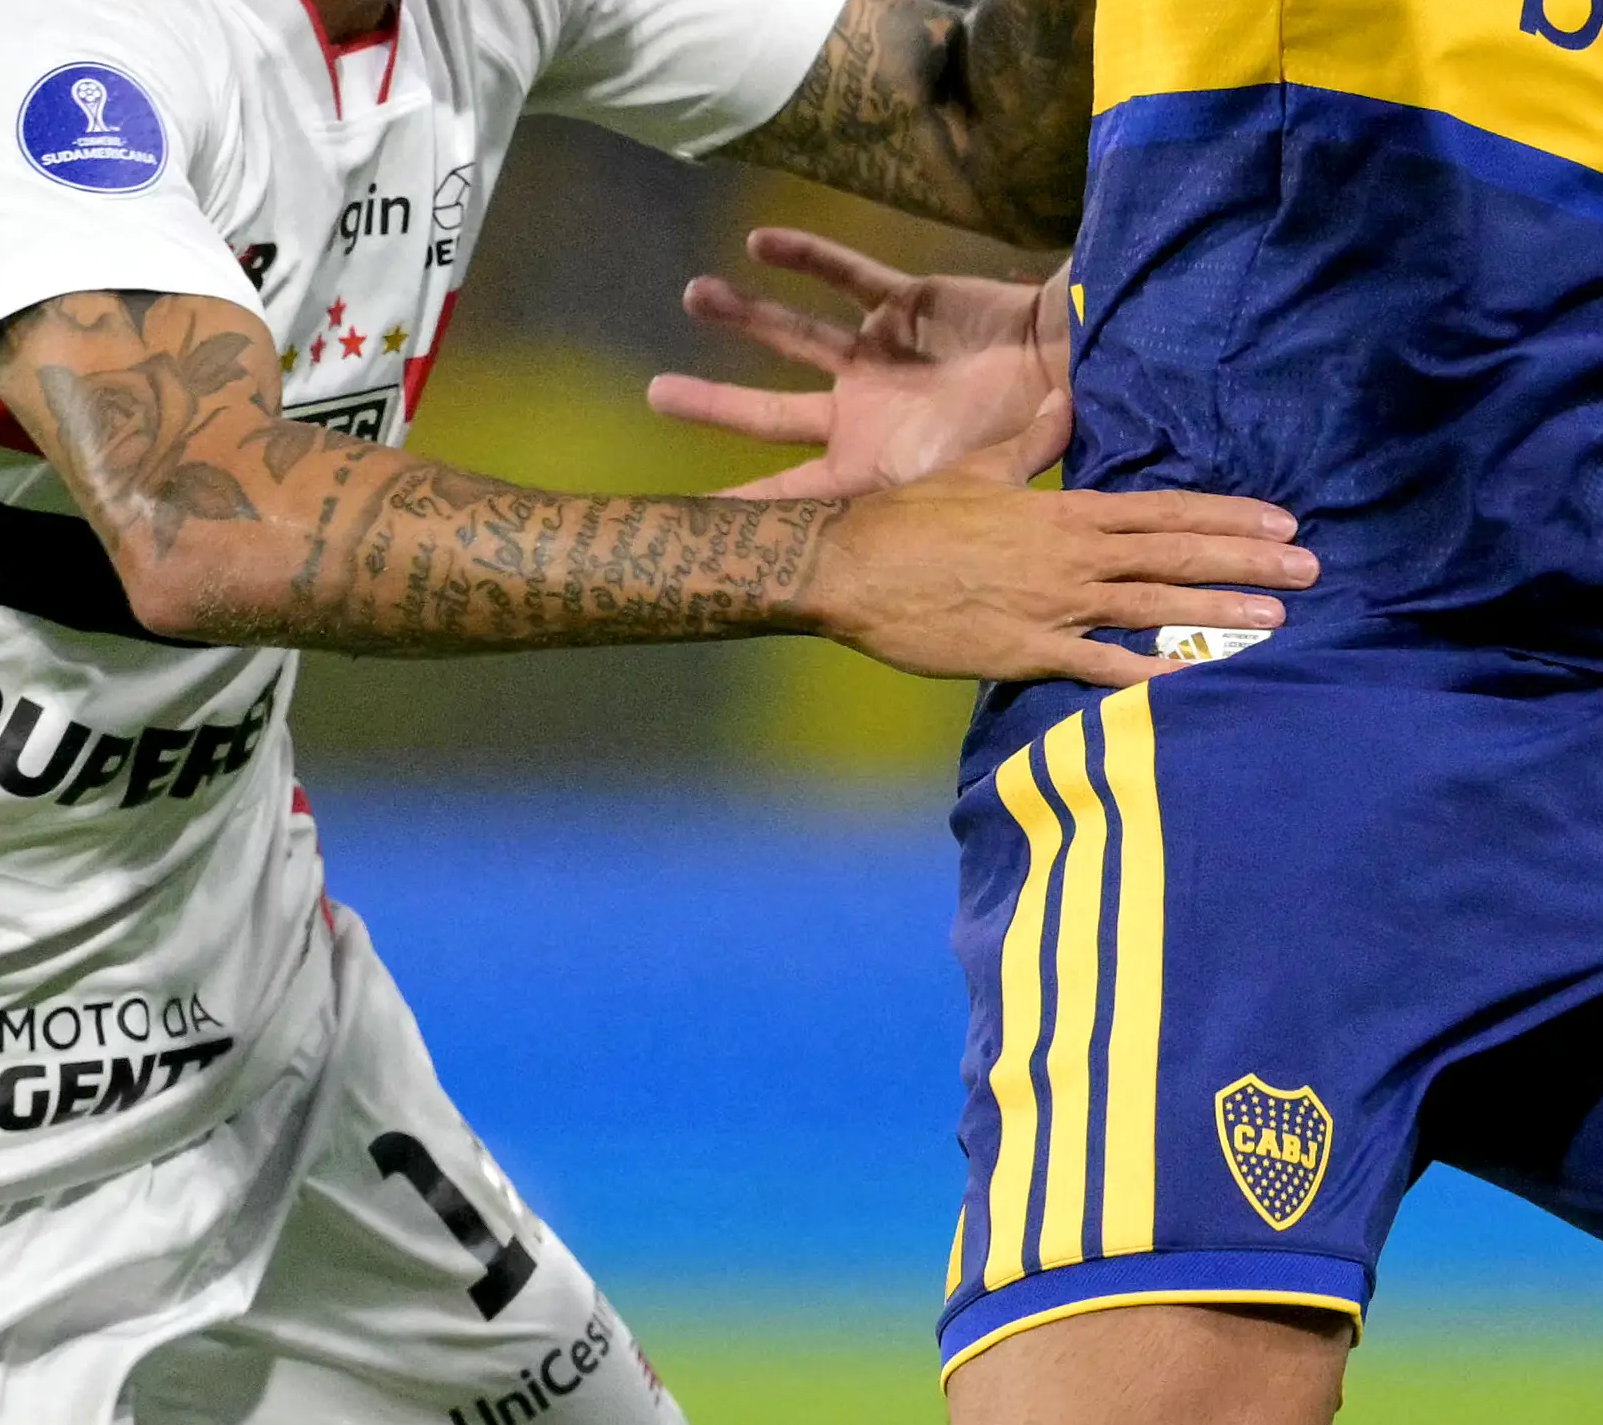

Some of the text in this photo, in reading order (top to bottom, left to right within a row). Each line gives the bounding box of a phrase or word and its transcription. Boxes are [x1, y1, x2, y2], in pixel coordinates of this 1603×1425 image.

[41, 147, 158, 166] SUDAMERICANA
[337, 182, 411, 256] gin
[162, 992, 225, 1039] DA
[1233, 1123, 1318, 1170] CABJ
